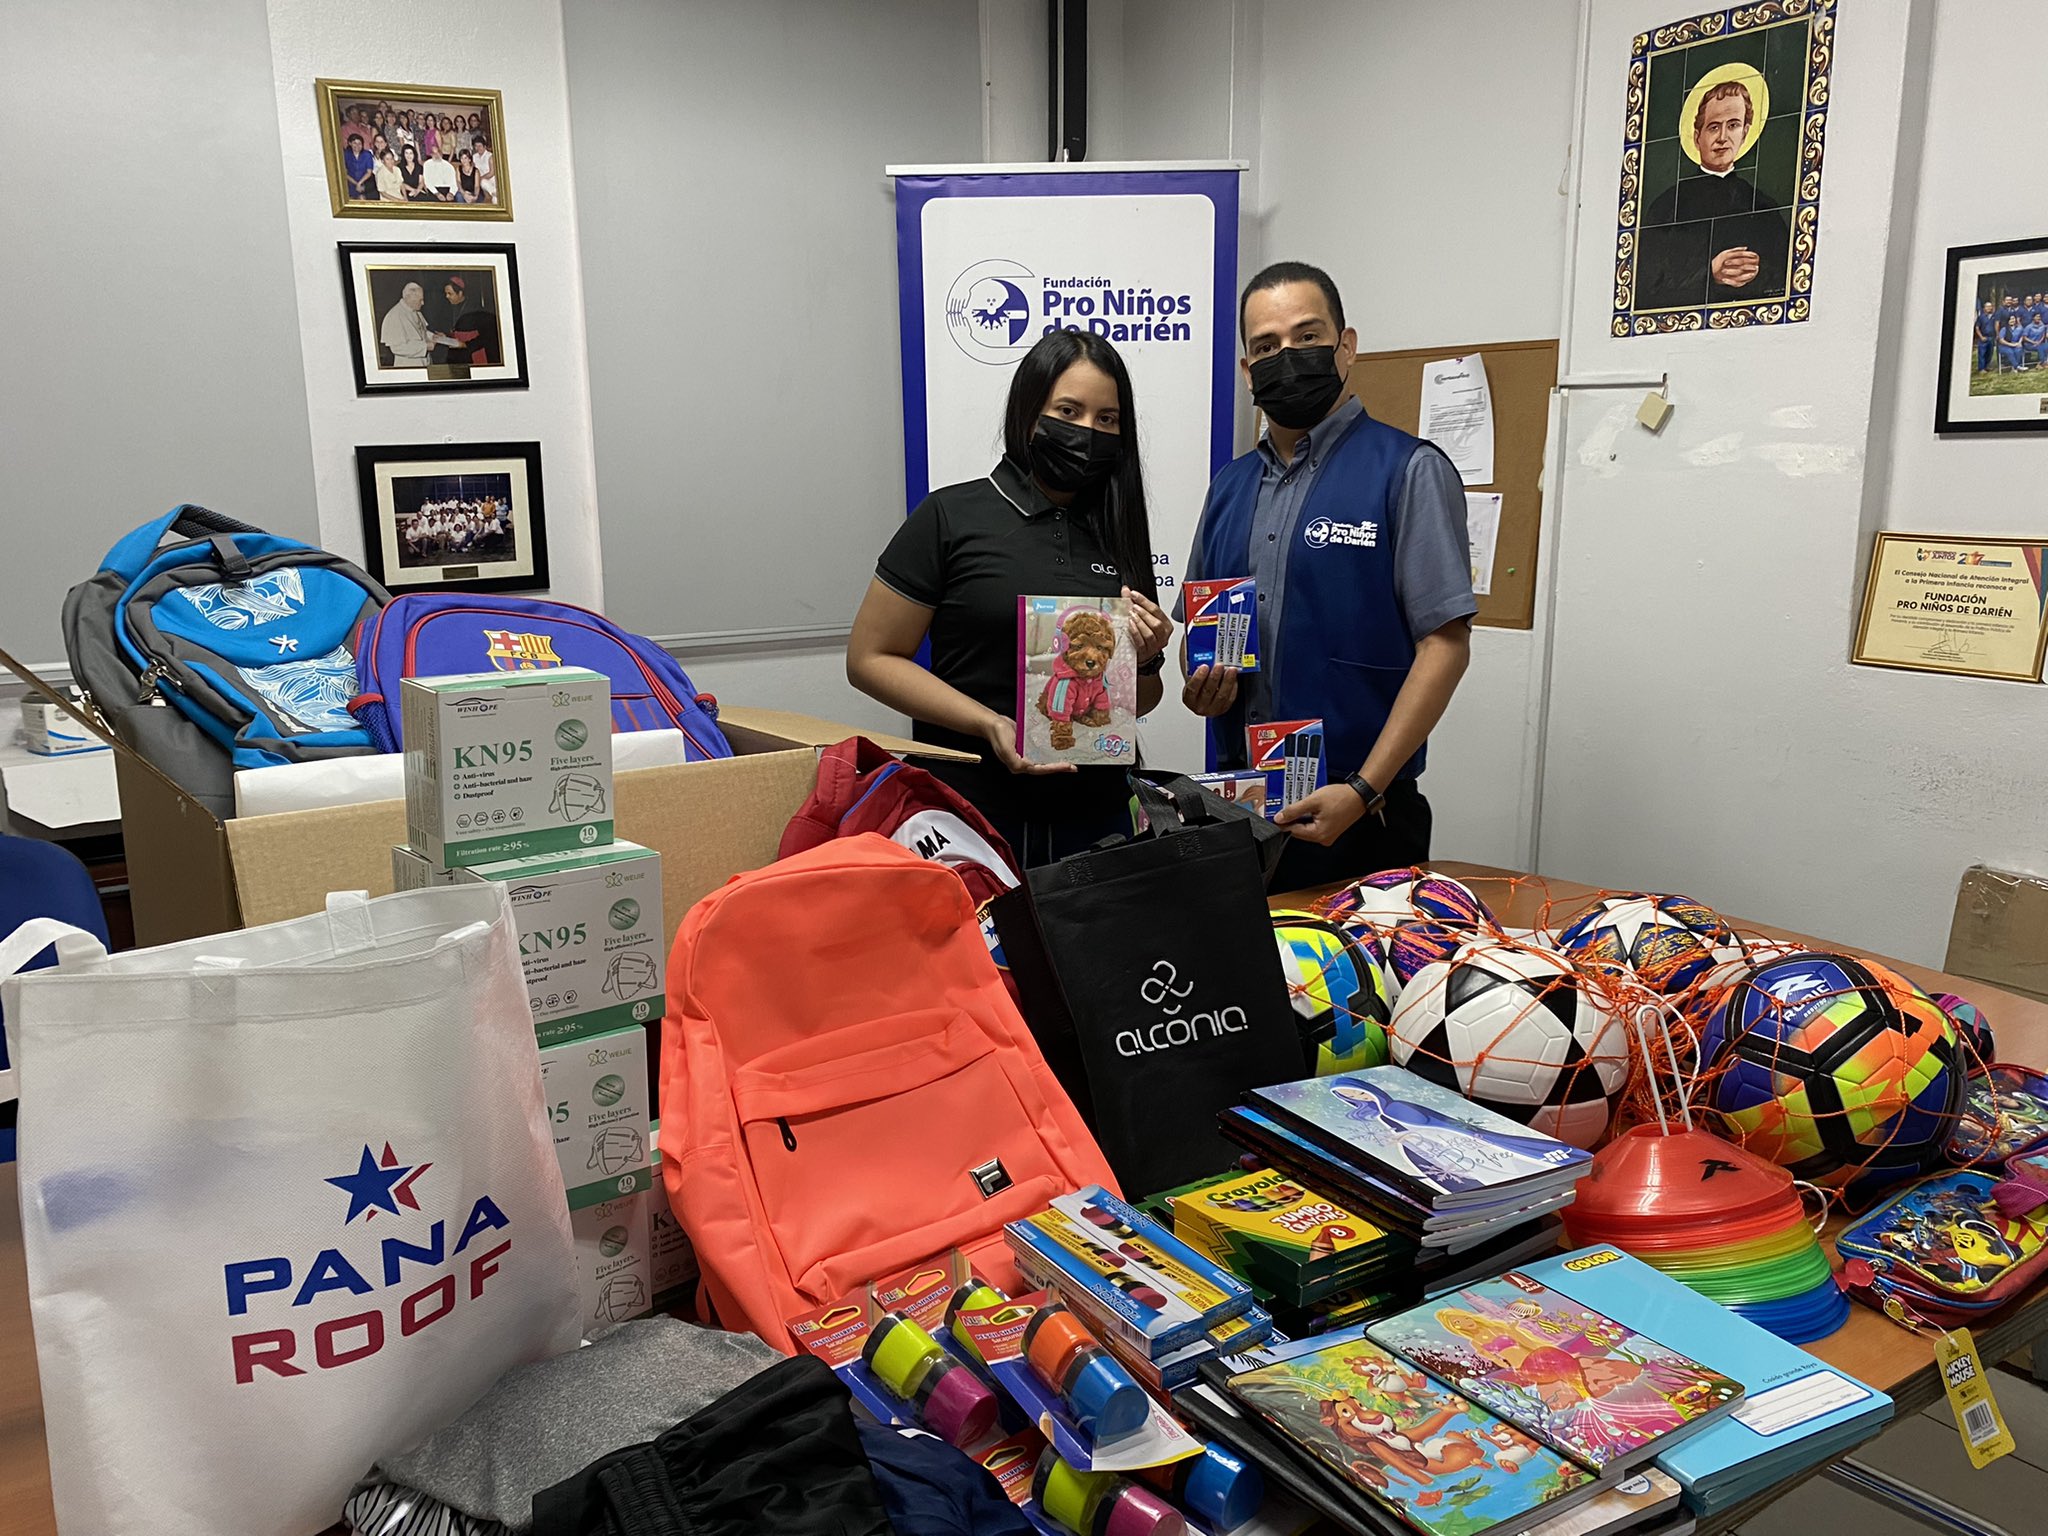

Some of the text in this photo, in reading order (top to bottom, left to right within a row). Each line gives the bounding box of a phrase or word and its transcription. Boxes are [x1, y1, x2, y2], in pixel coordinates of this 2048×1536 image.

[1043, 276, 1111, 288] Fundación
[1043, 288, 1191, 317] Pro Niños
[1042, 315, 1191, 342] de Darién
[1331, 527, 1349, 536] Pro
[1329, 535, 1376, 548] de Darién
[1901, 570, 1927, 578] Consejo
[1928, 572, 1958, 580] Nacional
[1975, 583, 2007, 591] reconoce
[1924, 592, 1987, 605] FUNDACIÓN
[1896, 600, 2013, 618] PRO NIÑOS DE DARIÉN
[1094, 733, 1131, 756] dogs
[452, 740, 533, 770] KN95
[550, 754, 595, 766] Five layers
[462, 771, 495, 780] Anti-virus
[462, 790, 494, 800] Dustproof
[1226, 789, 1235, 798] 3+
[583, 827, 595, 836] 10
[518, 922, 587, 956] KN95
[604, 932, 647, 946] Five layers
[635, 1004, 646, 1013] 10
[588, 1107, 632, 1123] Five layers
[621, 1177, 632, 1186] 10
[1206, 1173, 1288, 1203] Crayola
[1270, 1203, 1334, 1228] JUMBO
[1287, 1210, 1349, 1234] CRAYONS
[224, 1195, 511, 1316] PANA
[1565, 1250, 1620, 1271] COLOR
[595, 1254, 635, 1275] Five layers
[231, 1238, 512, 1385] ROOF
[1946, 1353, 1973, 1377] MICKEY
[1950, 1365, 1976, 1389] MOUSE
